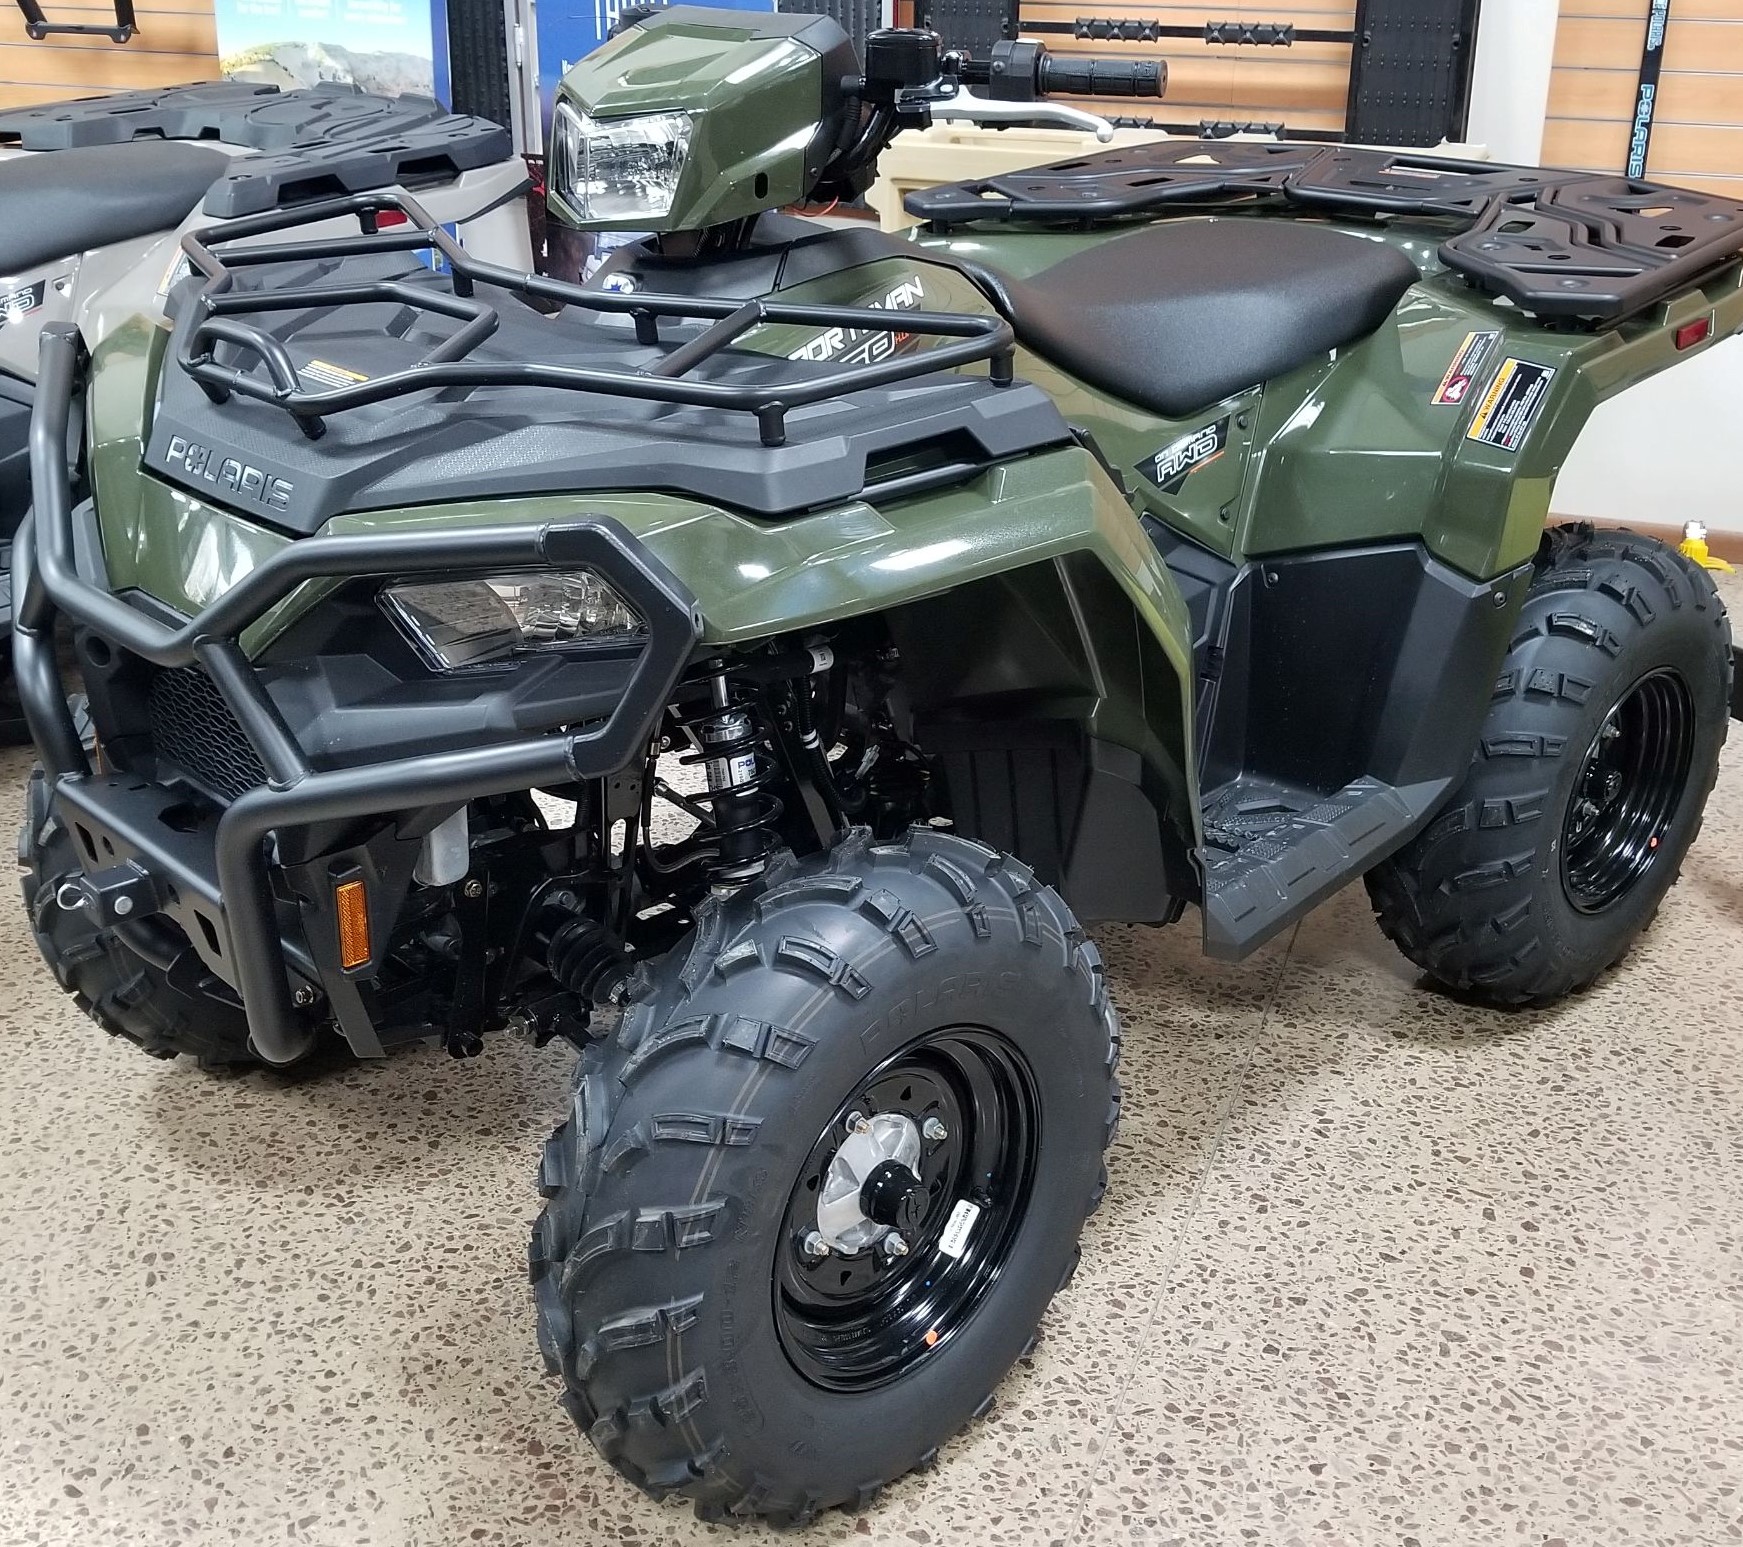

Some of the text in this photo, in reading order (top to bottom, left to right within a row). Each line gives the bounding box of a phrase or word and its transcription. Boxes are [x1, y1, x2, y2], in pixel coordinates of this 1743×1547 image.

[1629, 84, 1655, 178] POLARIS
[1484, 377, 1506, 410] WARNING
[164, 434, 295, 512] POLARIS
[1156, 433, 1218, 483] AWD
